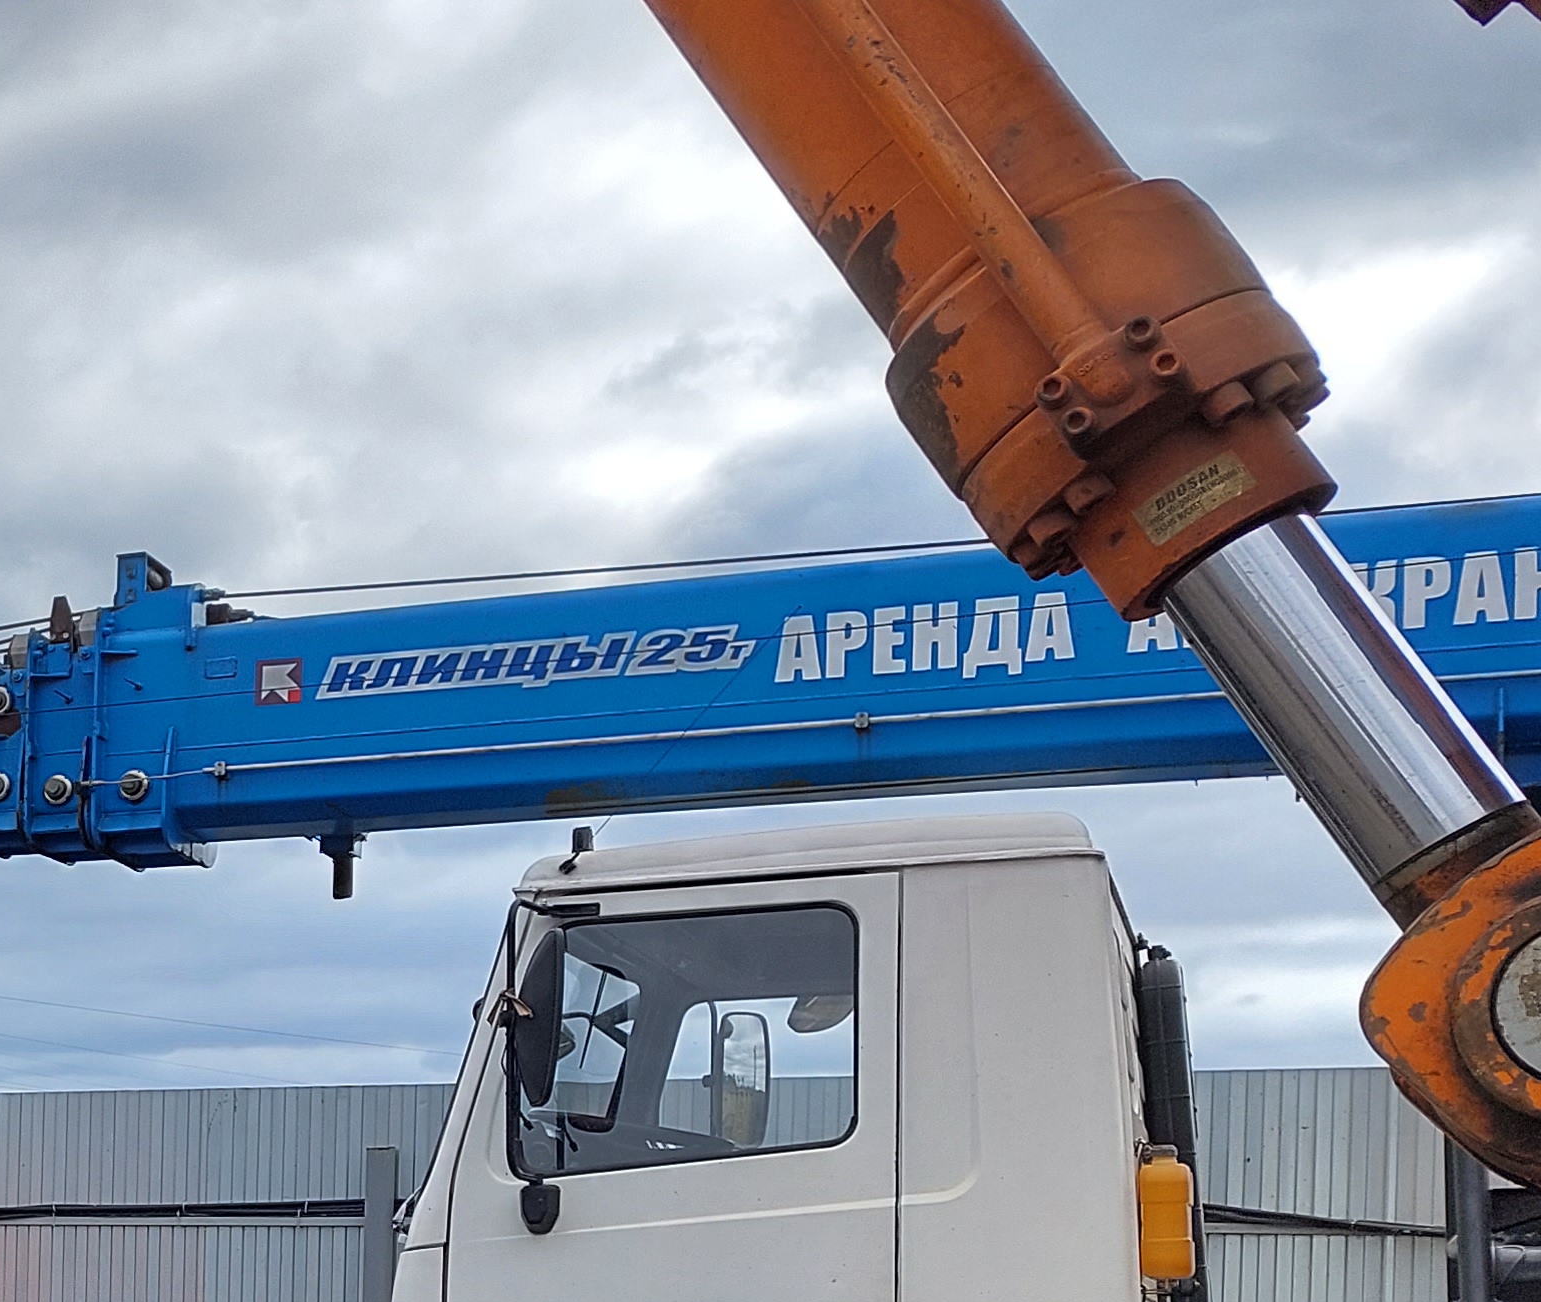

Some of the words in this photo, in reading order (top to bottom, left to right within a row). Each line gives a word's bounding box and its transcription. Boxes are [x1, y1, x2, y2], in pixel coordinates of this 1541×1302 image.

[1155, 464, 1220, 511] DOOSAN
[321, 634, 631, 695] КЛИНЦЫ
[774, 592, 1076, 682] АРЕНДА
